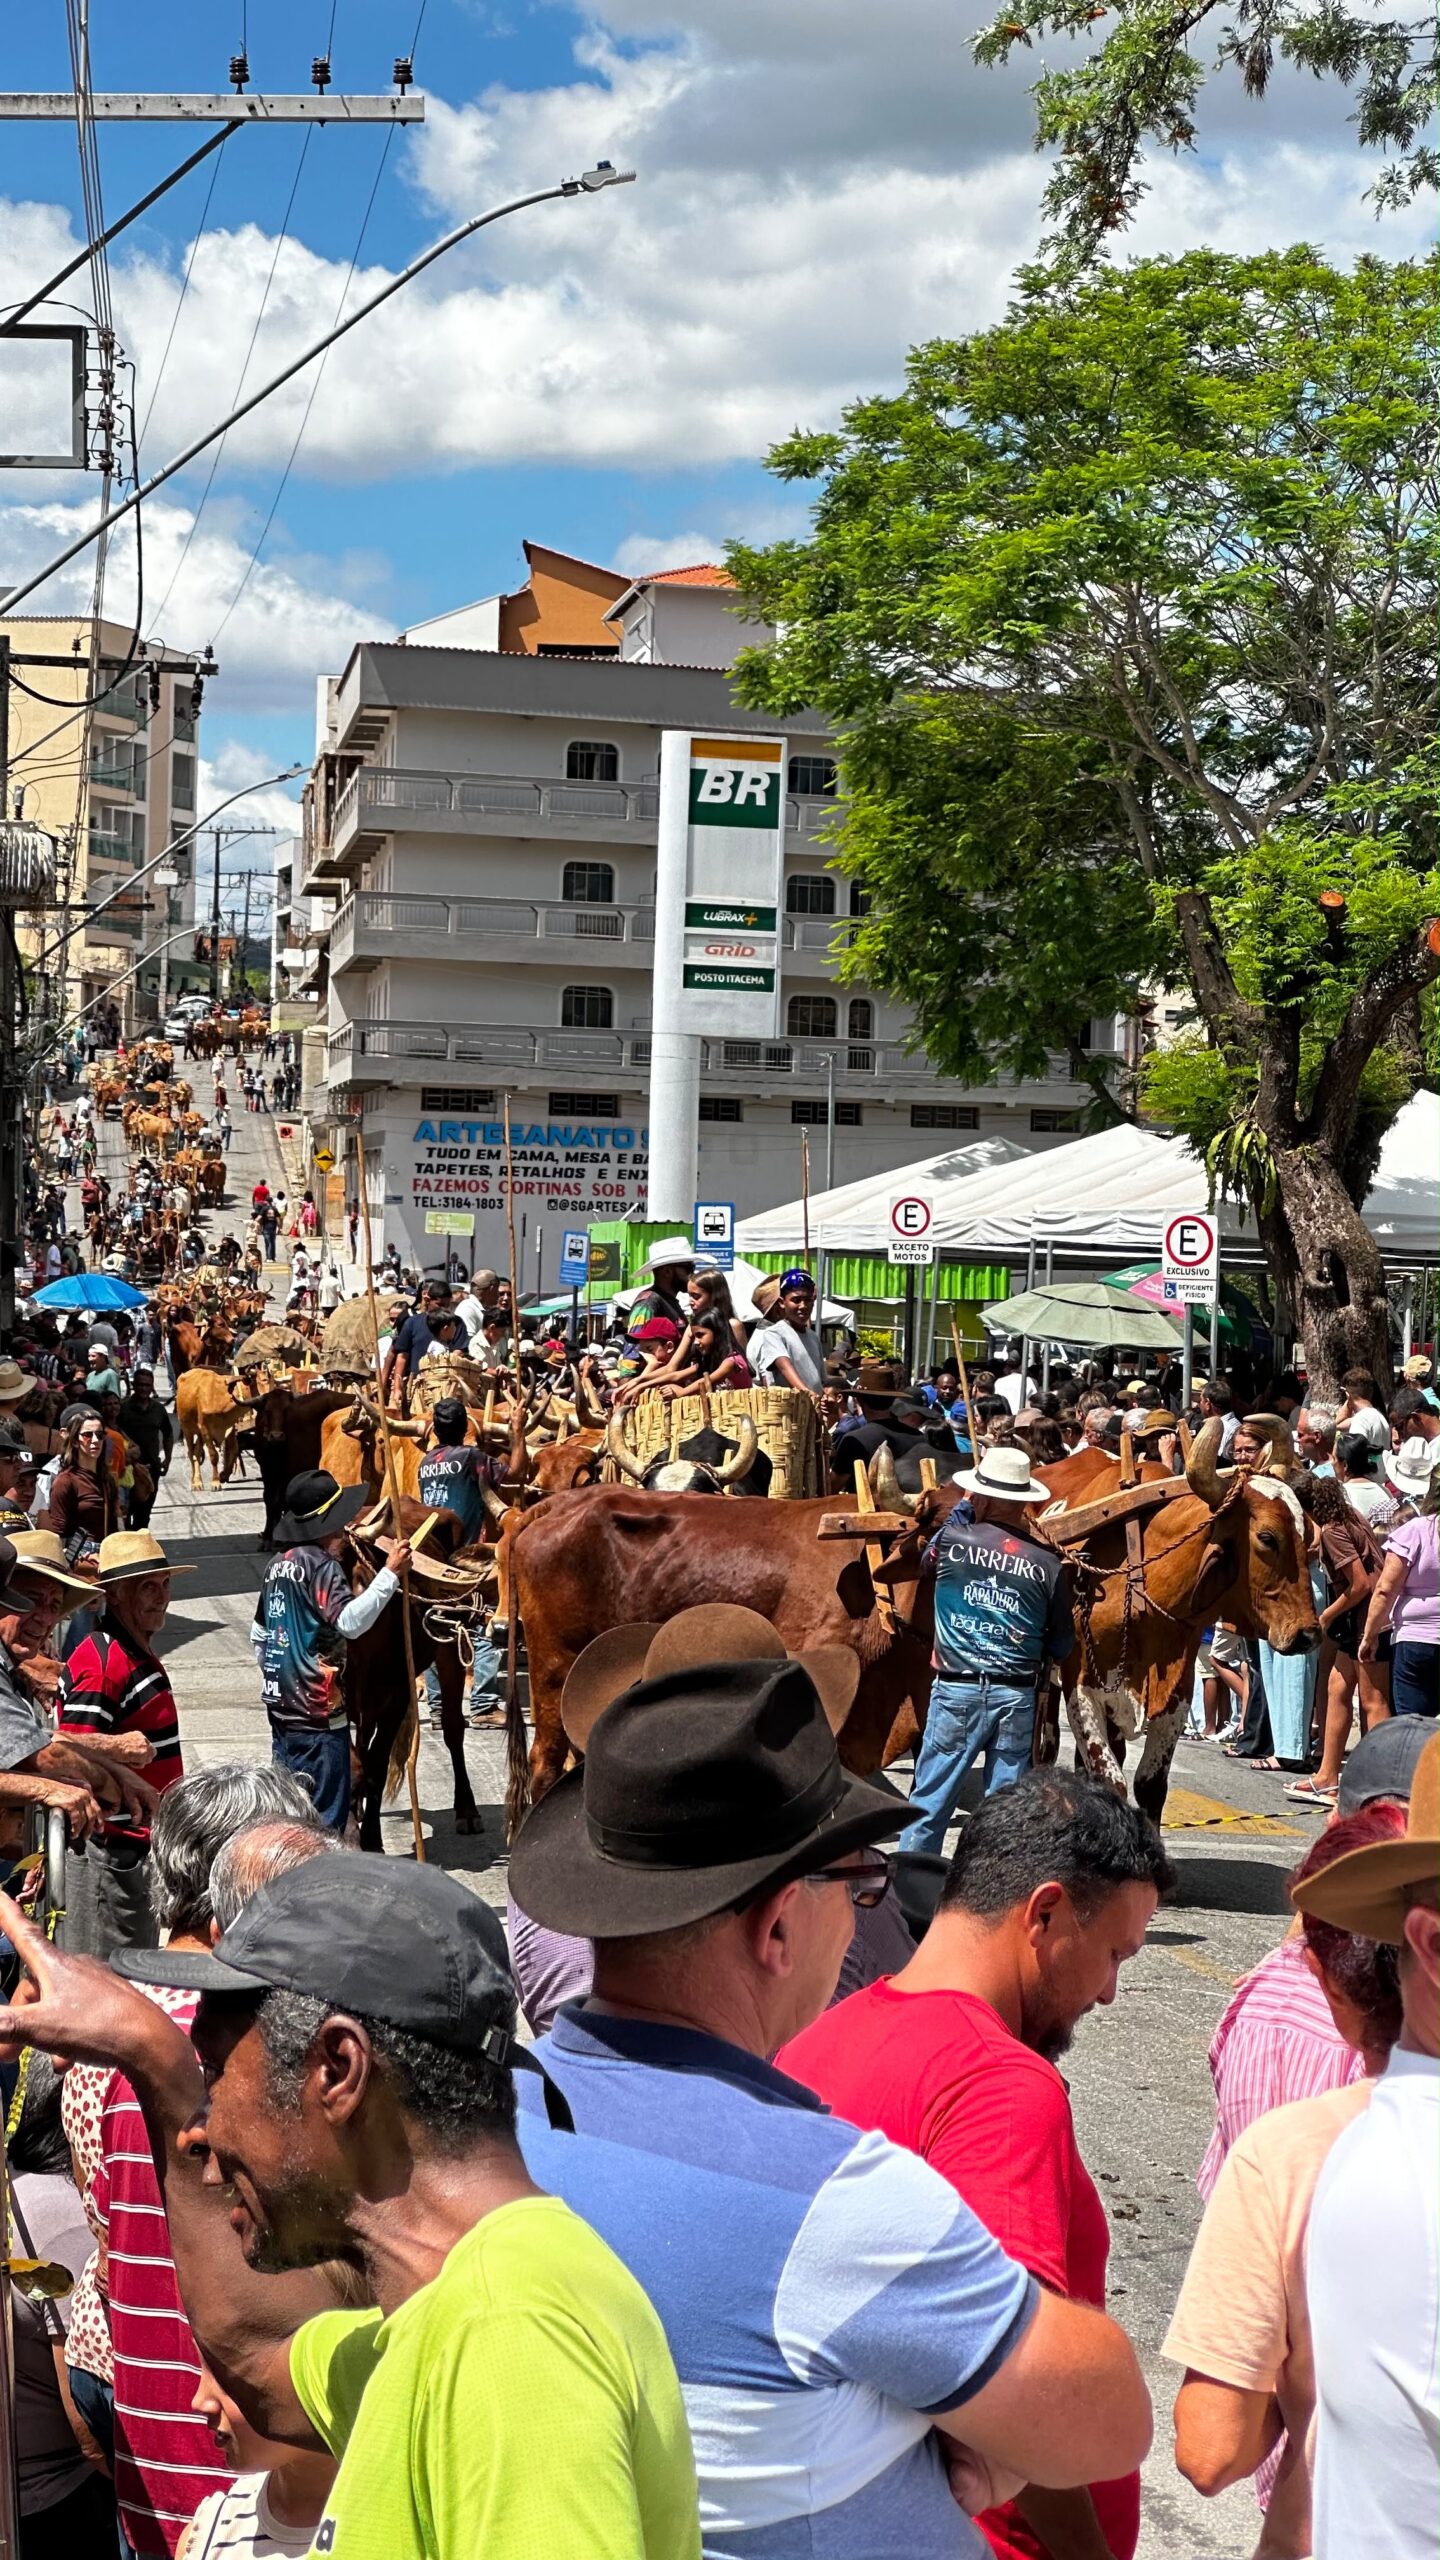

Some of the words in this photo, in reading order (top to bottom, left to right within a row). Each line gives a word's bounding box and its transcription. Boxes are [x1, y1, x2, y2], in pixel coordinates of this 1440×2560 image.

[697, 769, 770, 806] BR
[694, 972, 725, 983] POSTO
[413, 1120, 635, 1149] ARTESANATO
[426, 1147, 470, 1160] TUDO
[476, 1149, 501, 1161] EM
[507, 1150, 559, 1165] CAMA,
[565, 1152, 611, 1164] MESA
[617, 1153, 628, 1165] E
[414, 1162, 493, 1179] TAPETES,
[498, 1165, 586, 1179] RETALHOS
[597, 1168, 608, 1180] E
[412, 1178, 490, 1194] FAZEMOS
[498, 1180, 582, 1196] CORTINAS
[592, 1182, 626, 1197] SOB
[559, 1199, 649, 1213] @SGARTESAN
[903, 1204, 919, 1228] E
[892, 1243, 930, 1253] EXCETO
[1179, 1224, 1198, 1256] E
[893, 1252, 927, 1262] MOTOS
[1166, 1266, 1210, 1277] EXCLUSIVO
[1178, 1284, 1214, 1292] DEFICIENTE
[948, 1543, 1046, 1584] CARREIRO
[963, 1584, 1020, 1616] RAPADURA
[950, 1612, 1004, 1636] Itaguara
